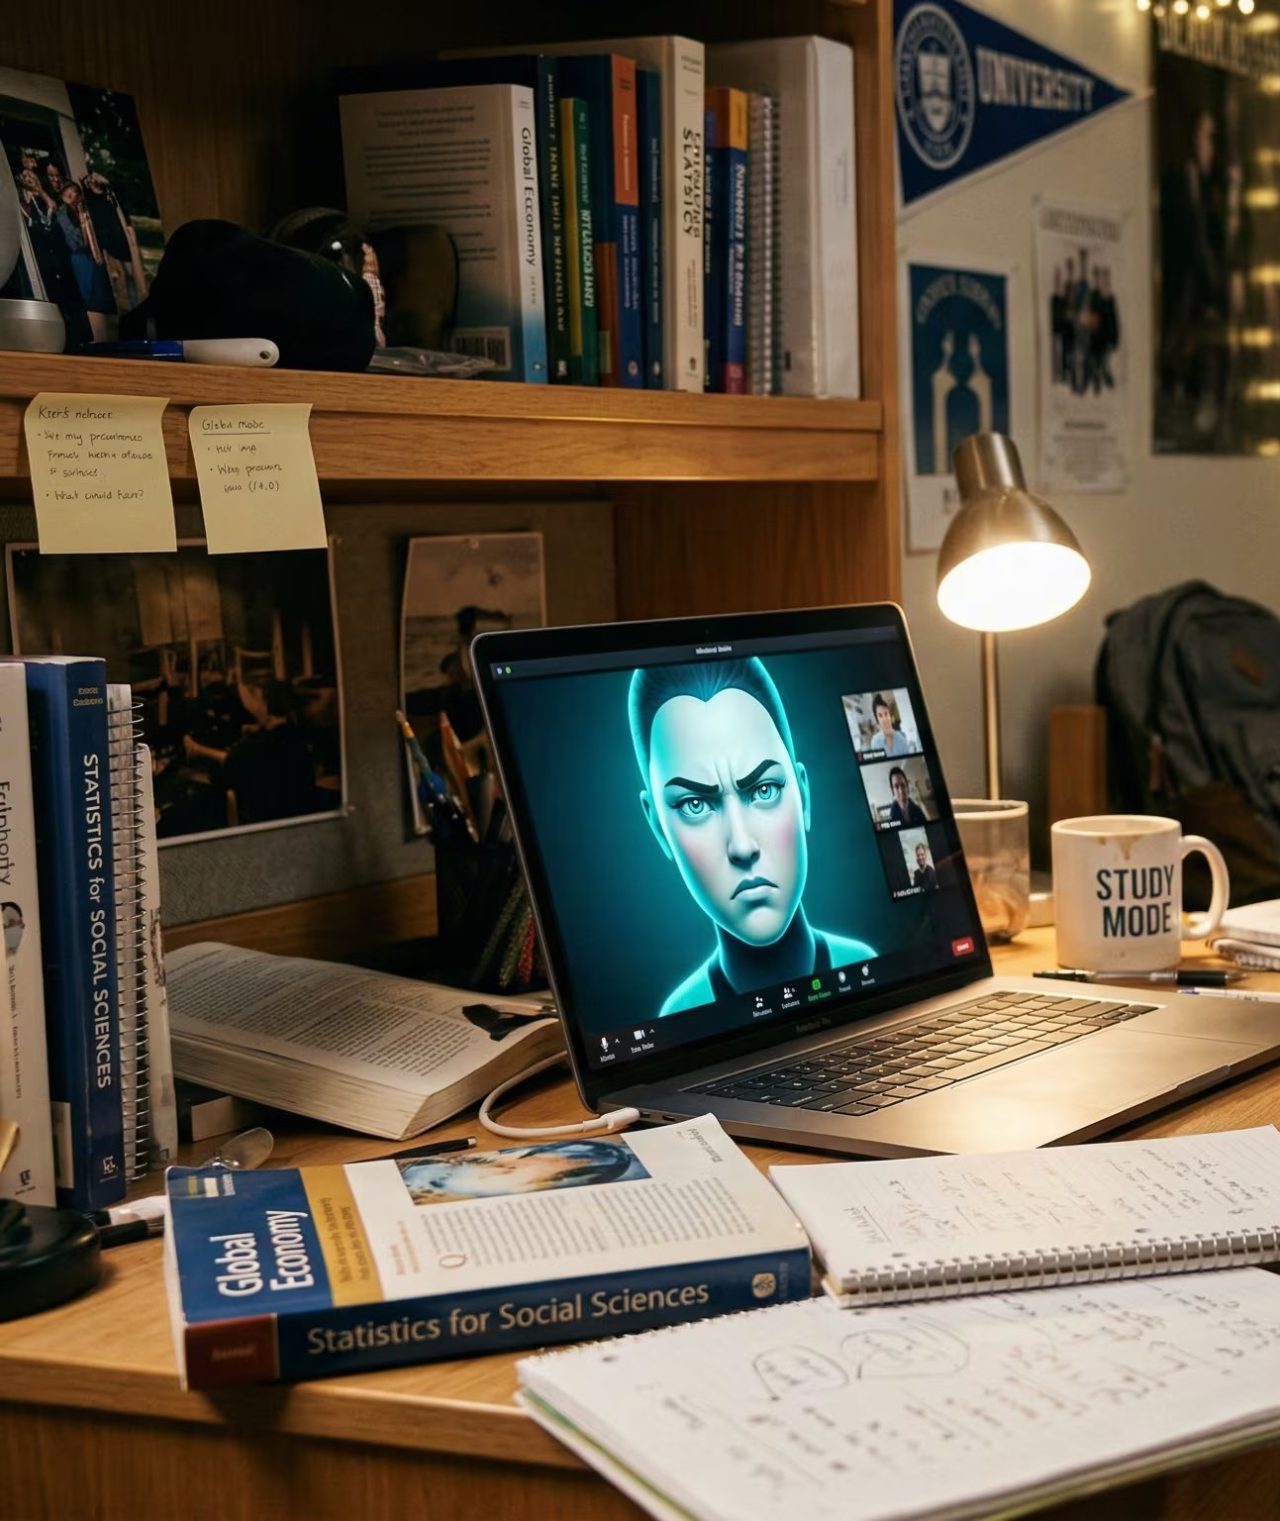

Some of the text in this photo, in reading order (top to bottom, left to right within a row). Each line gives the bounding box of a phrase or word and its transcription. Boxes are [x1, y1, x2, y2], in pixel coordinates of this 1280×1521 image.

[976, 45, 1094, 112] UNIVERSITY
[521, 127, 534, 180] Global
[1096, 865, 1175, 901] STUDY
[84, 754, 111, 1088] STATISTICS for SOCIAL SCIENCES
[1103, 902, 1172, 938] MODE
[209, 1232, 263, 1297] Global
[265, 1210, 314, 1291] Economy
[306, 1283, 710, 1355] Statistics for Social Sciences
